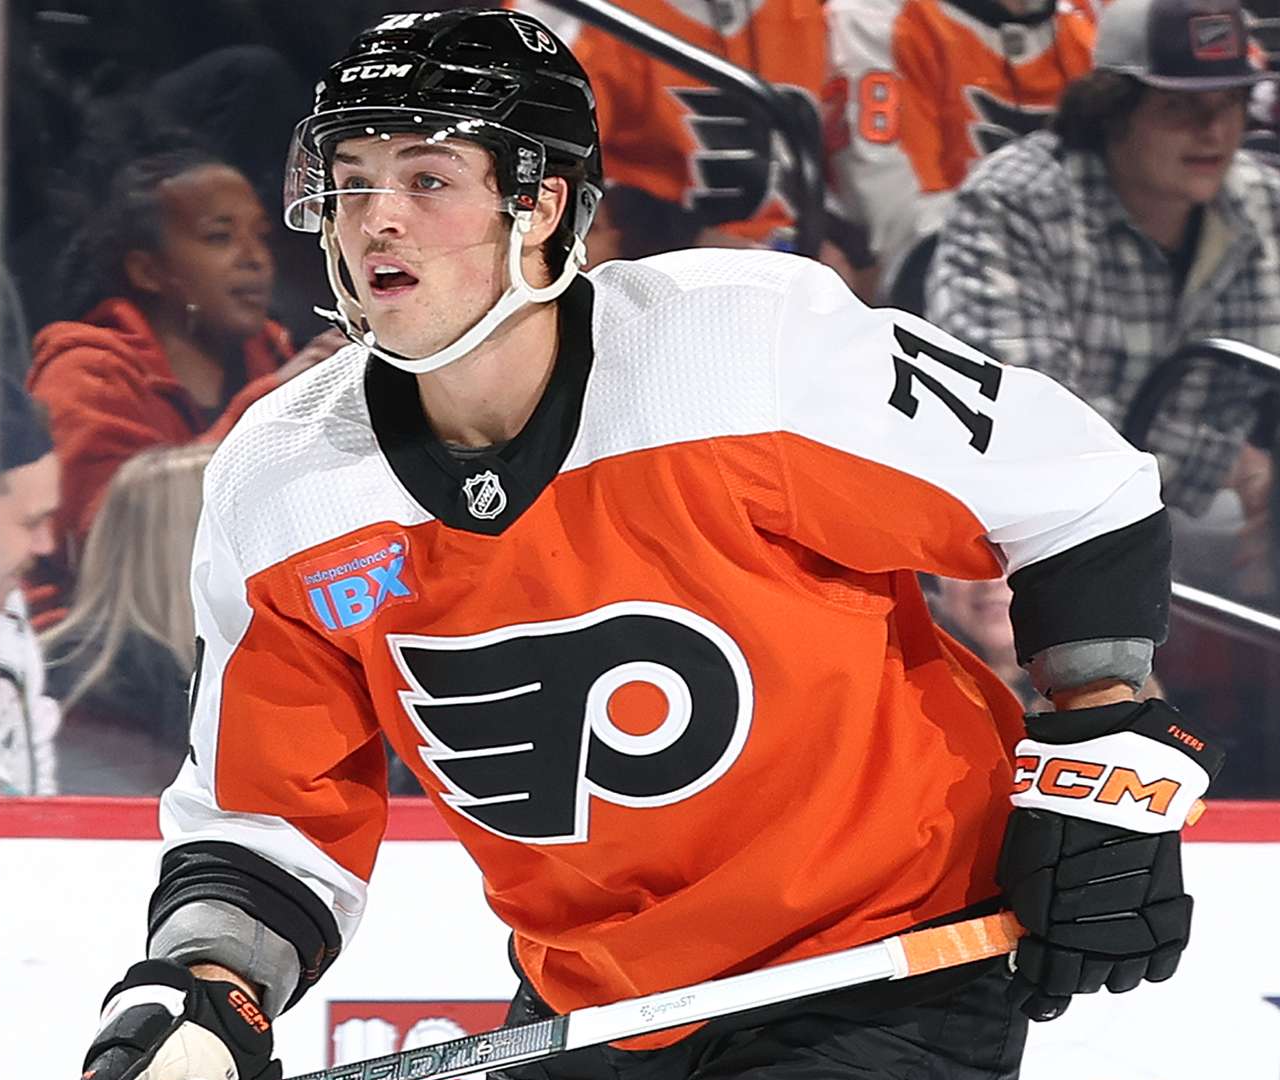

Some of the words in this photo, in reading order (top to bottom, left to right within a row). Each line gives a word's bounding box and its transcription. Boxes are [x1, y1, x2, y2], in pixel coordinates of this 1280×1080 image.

[340, 64, 413, 83] CCM
[888, 323, 1003, 455] 71
[308, 556, 412, 630] IBX
[1167, 724, 1205, 752] FLYERS
[228, 990, 270, 1031] CCM
